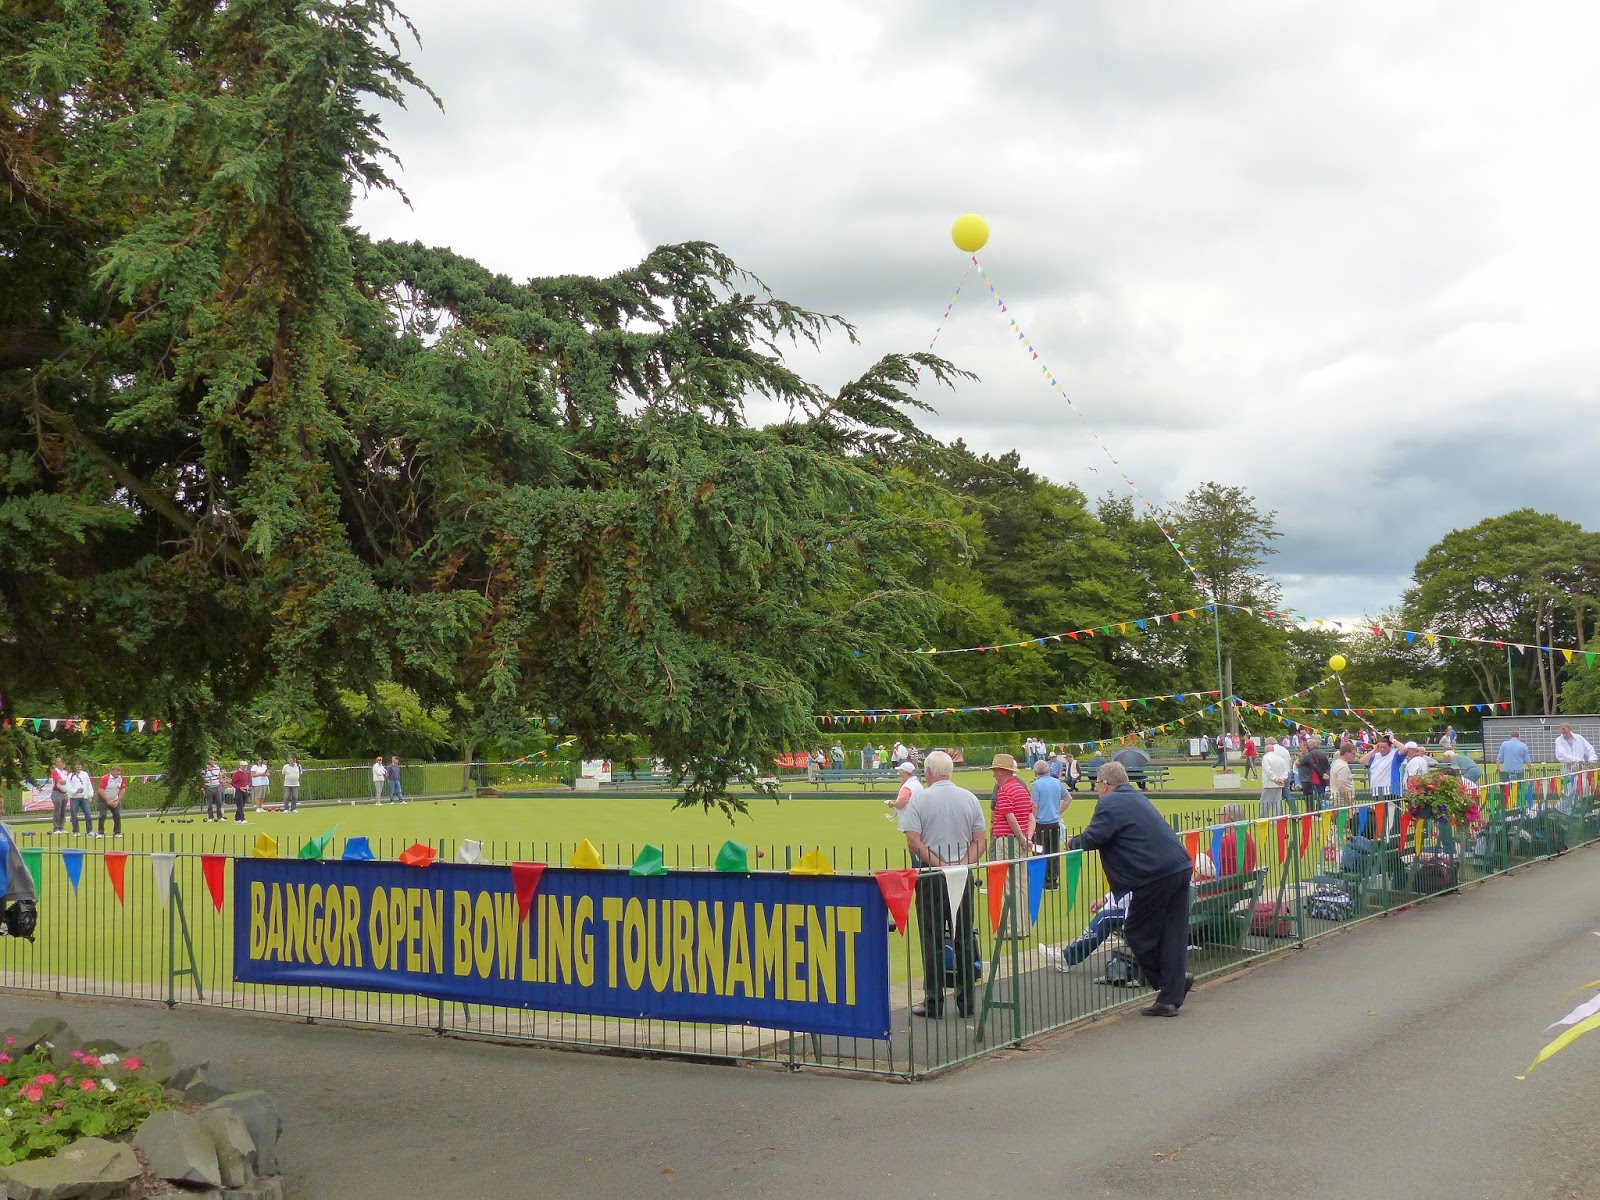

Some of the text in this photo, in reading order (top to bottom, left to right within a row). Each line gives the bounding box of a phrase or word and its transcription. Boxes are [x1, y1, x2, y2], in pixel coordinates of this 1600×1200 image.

[249, 881, 862, 1006] BANGOR OPEN BOWLING TOURNAMENT
